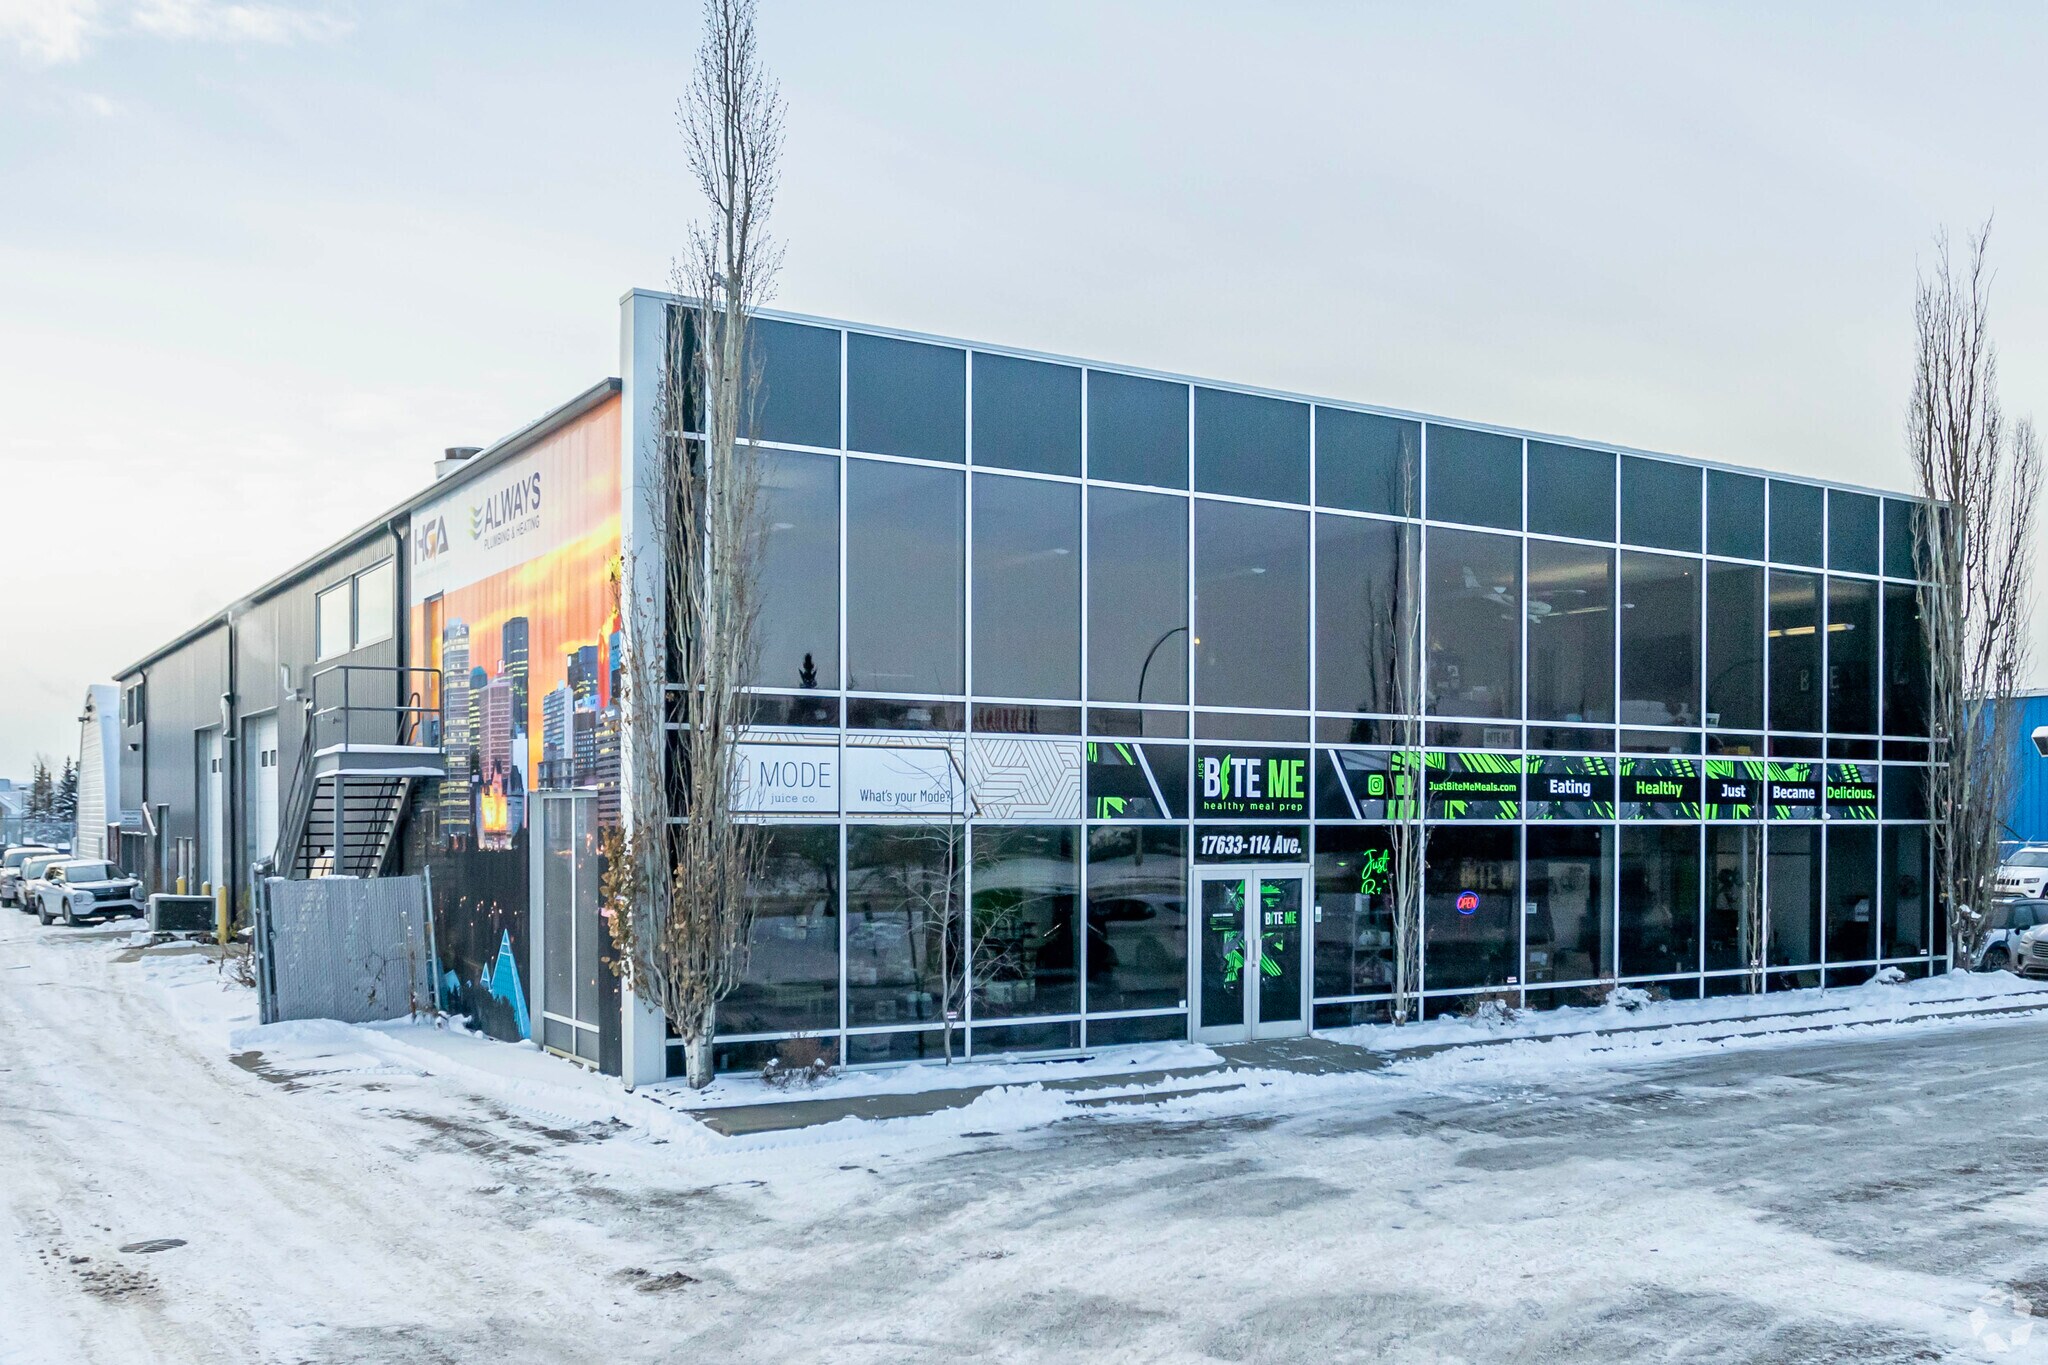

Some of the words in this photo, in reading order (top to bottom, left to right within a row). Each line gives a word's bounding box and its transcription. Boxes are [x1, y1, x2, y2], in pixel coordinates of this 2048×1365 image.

[484, 472, 540, 533] ALWAYS
[484, 528, 510, 551] PLUMBING
[516, 514, 540, 536] HEATING
[760, 761, 831, 788] MODE
[1267, 759, 1305, 798] ME
[1428, 781, 1517, 792] JustBiteMeMeals.com
[1549, 779, 1591, 797] Eating
[1636, 781, 1683, 798] Healthy
[1721, 783, 1746, 798] Just
[1772, 785, 1815, 799] Became
[1826, 786, 1876, 799] Delicious.
[771, 793, 798, 805] juice
[895, 792, 917, 806] your
[920, 789, 951, 803] Mode?
[1203, 801, 1245, 812] healthy
[1249, 802, 1275, 810] meal
[1279, 803, 1303, 812] prep
[1201, 835, 1271, 855] 17633-114
[1272, 834, 1302, 854] Ave.
[1362, 849, 1390, 880] Just
[1458, 896, 1478, 909] OPEN
[1284, 911, 1297, 924] ME
